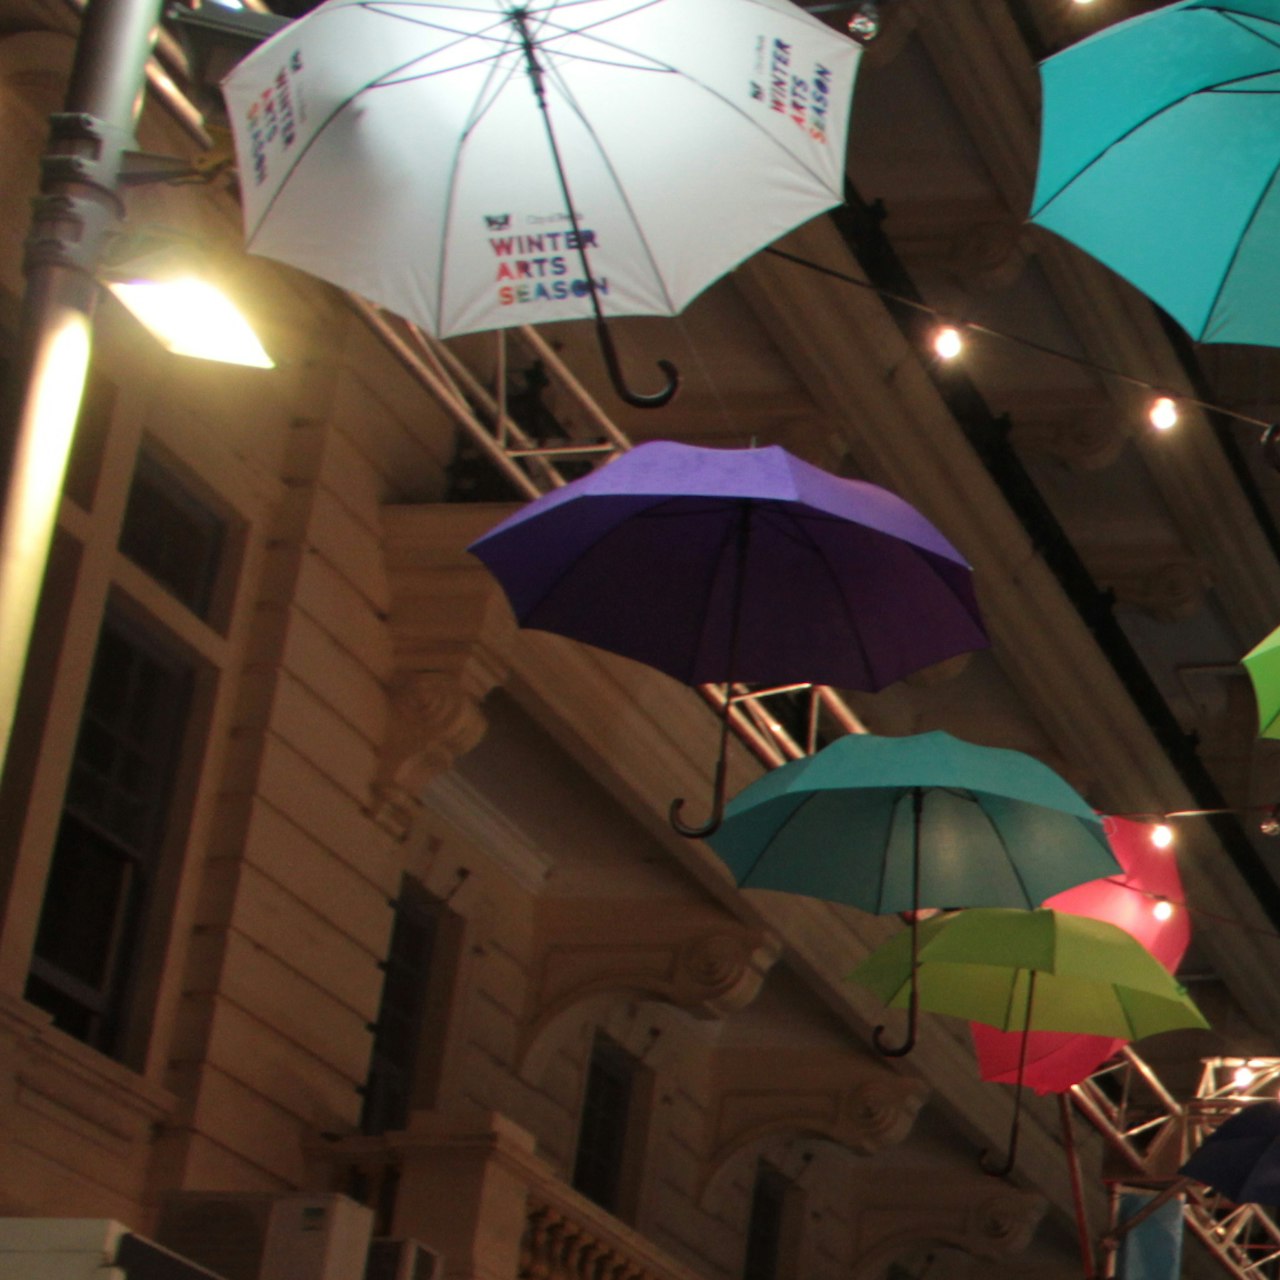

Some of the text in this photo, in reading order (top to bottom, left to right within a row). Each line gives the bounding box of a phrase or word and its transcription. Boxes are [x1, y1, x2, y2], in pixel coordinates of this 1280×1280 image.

[489, 229, 598, 257] WINTER
[496, 256, 568, 282] ARTS
[498, 277, 609, 306] SEASON
